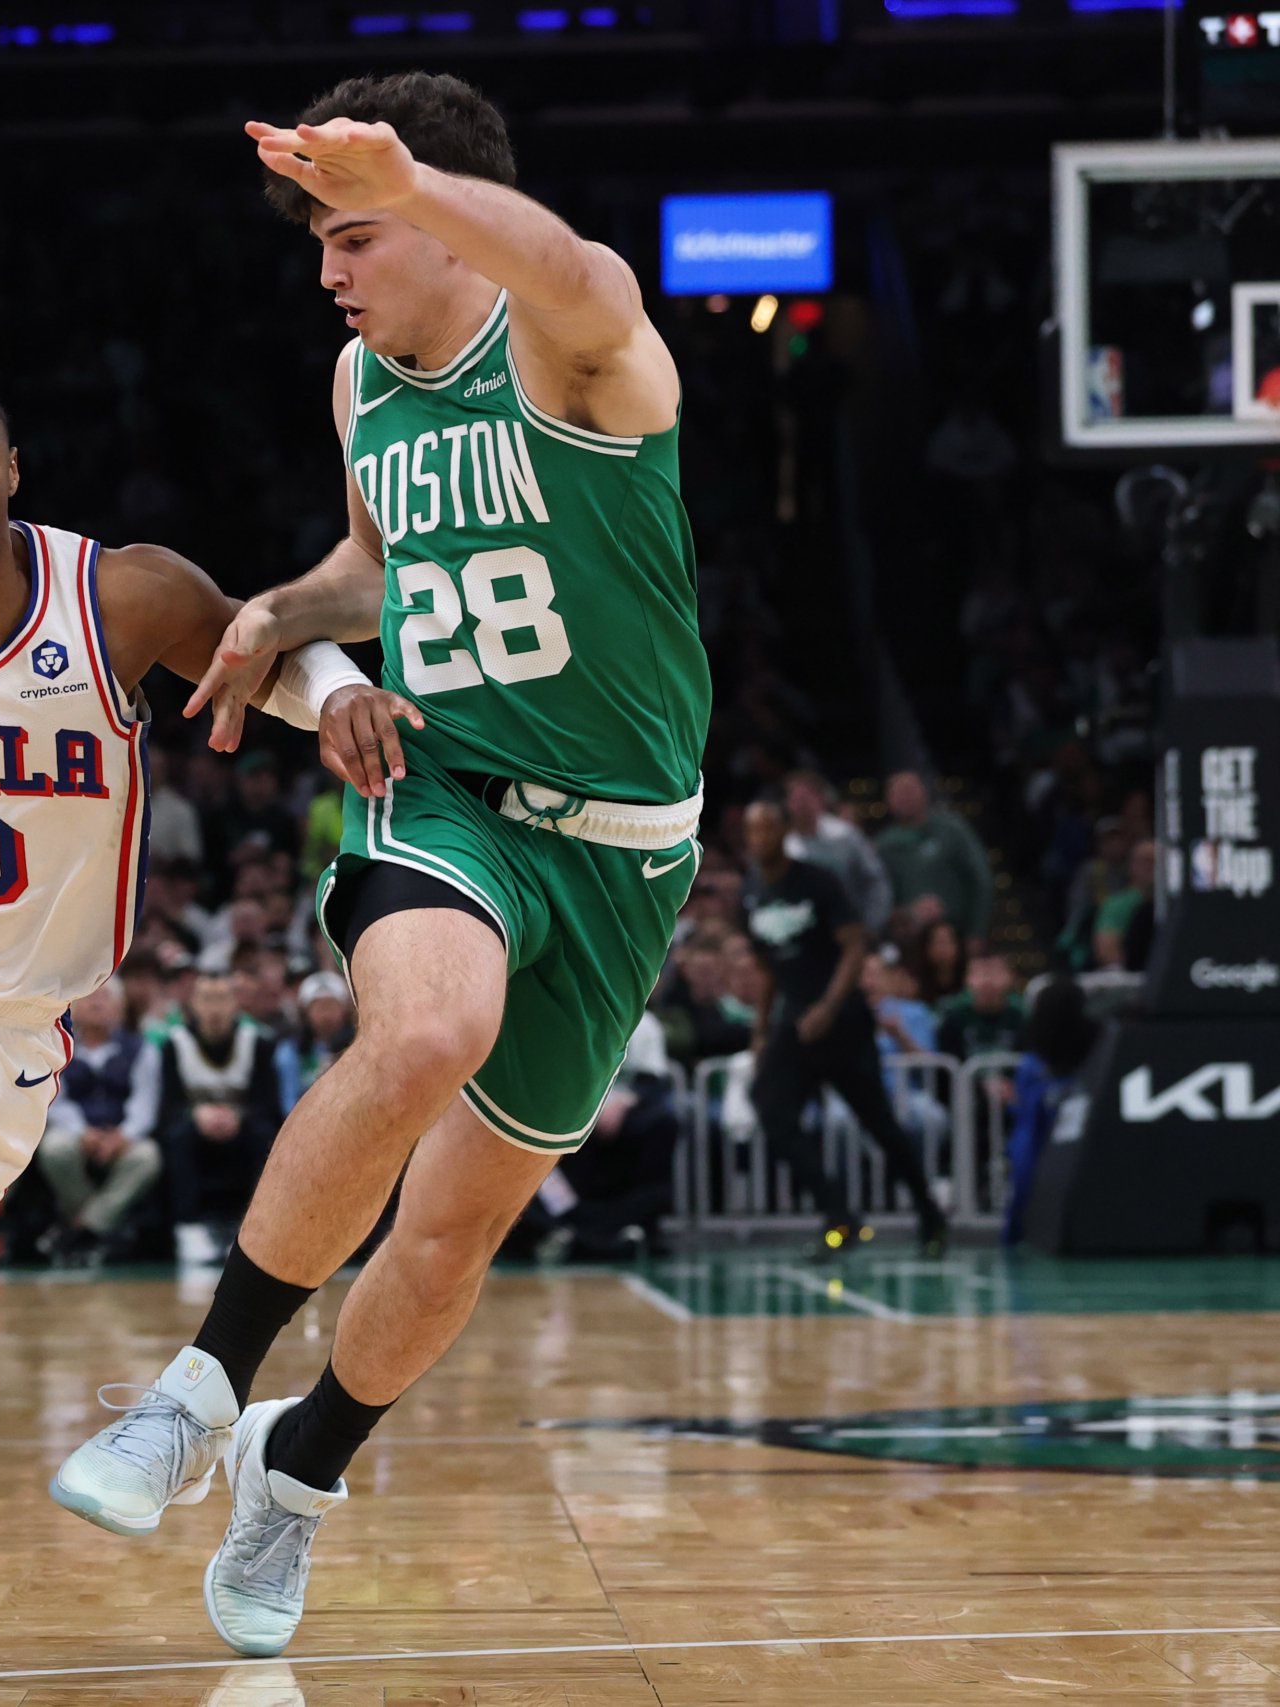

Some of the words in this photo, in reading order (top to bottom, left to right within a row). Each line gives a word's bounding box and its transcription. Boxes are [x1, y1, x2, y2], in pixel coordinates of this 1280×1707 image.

[464, 371, 507, 398] Amica
[354, 420, 550, 558] BOSTON
[397, 546, 572, 696] 28
[20, 682, 89, 699] crypto.com
